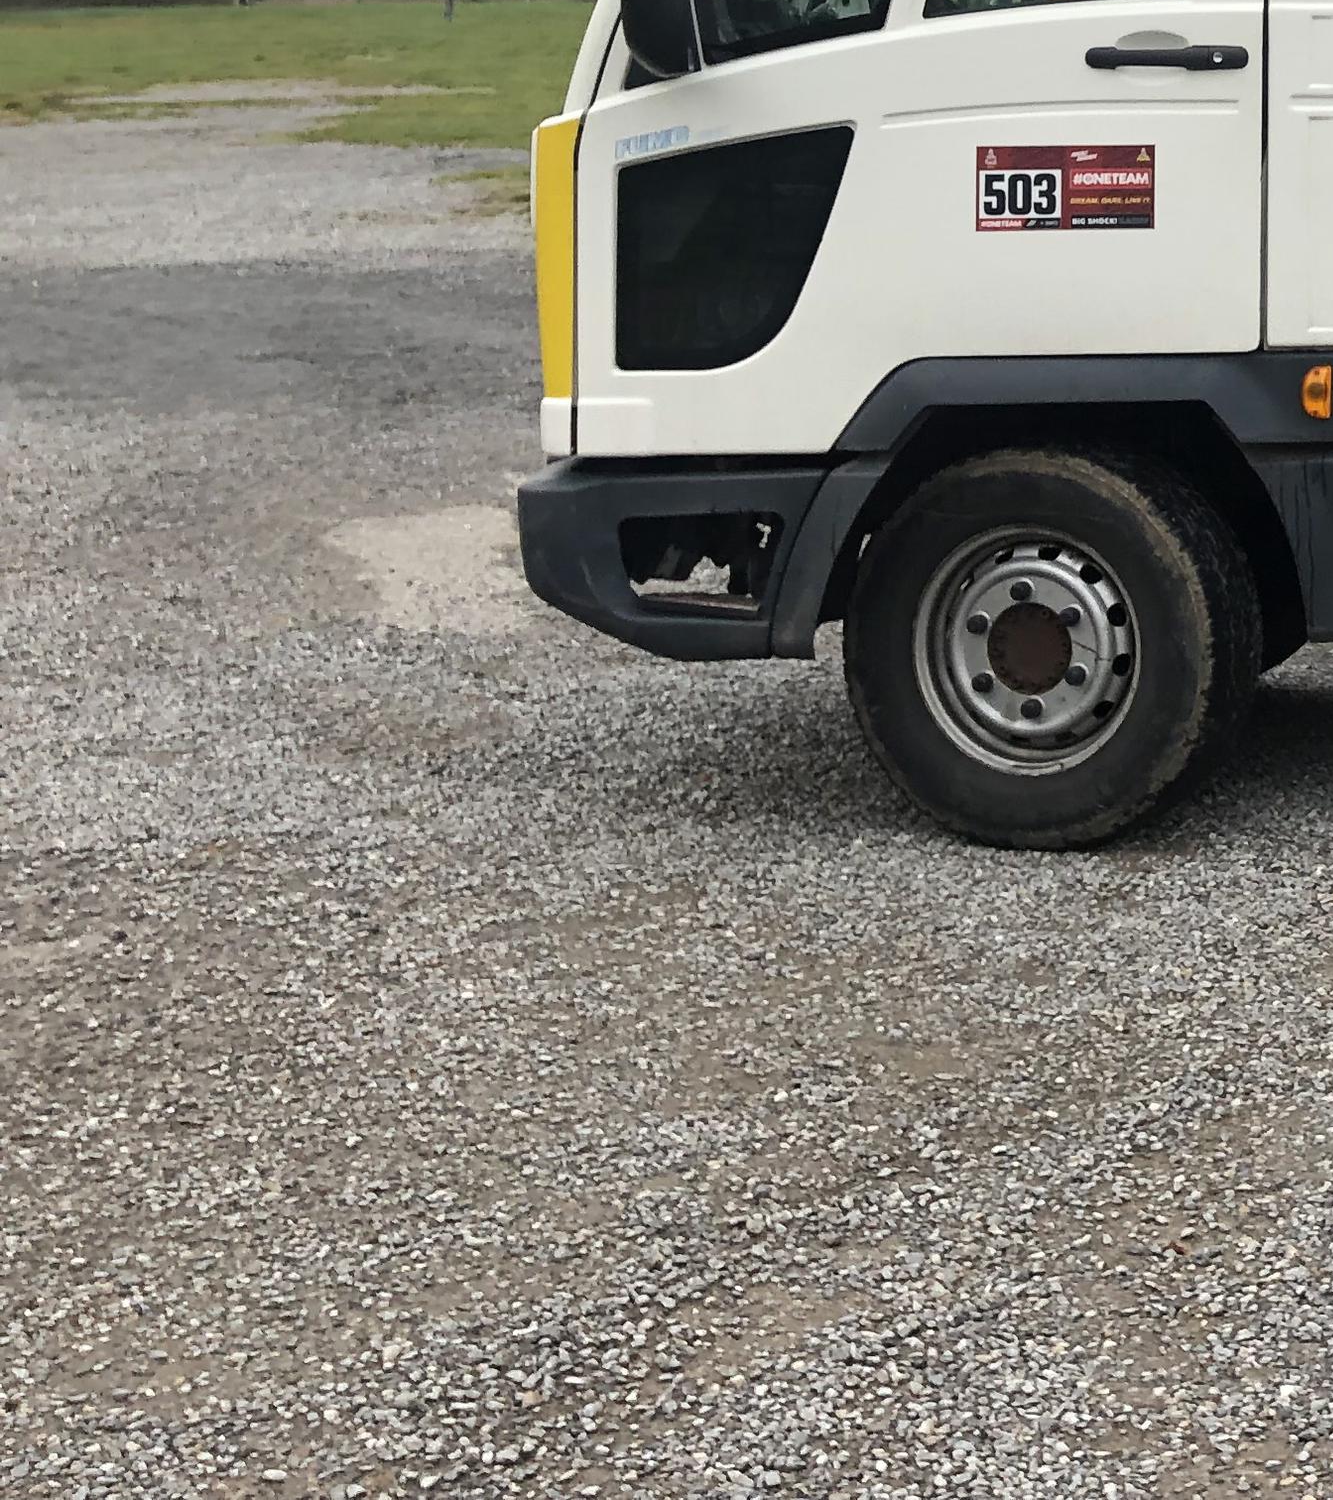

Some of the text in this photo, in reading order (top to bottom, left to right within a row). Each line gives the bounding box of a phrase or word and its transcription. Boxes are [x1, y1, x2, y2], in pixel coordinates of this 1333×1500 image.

[1072, 172, 1150, 186] #ONETEAM
[983, 173, 1057, 216] 503
[1071, 217, 1086, 225] BIG
